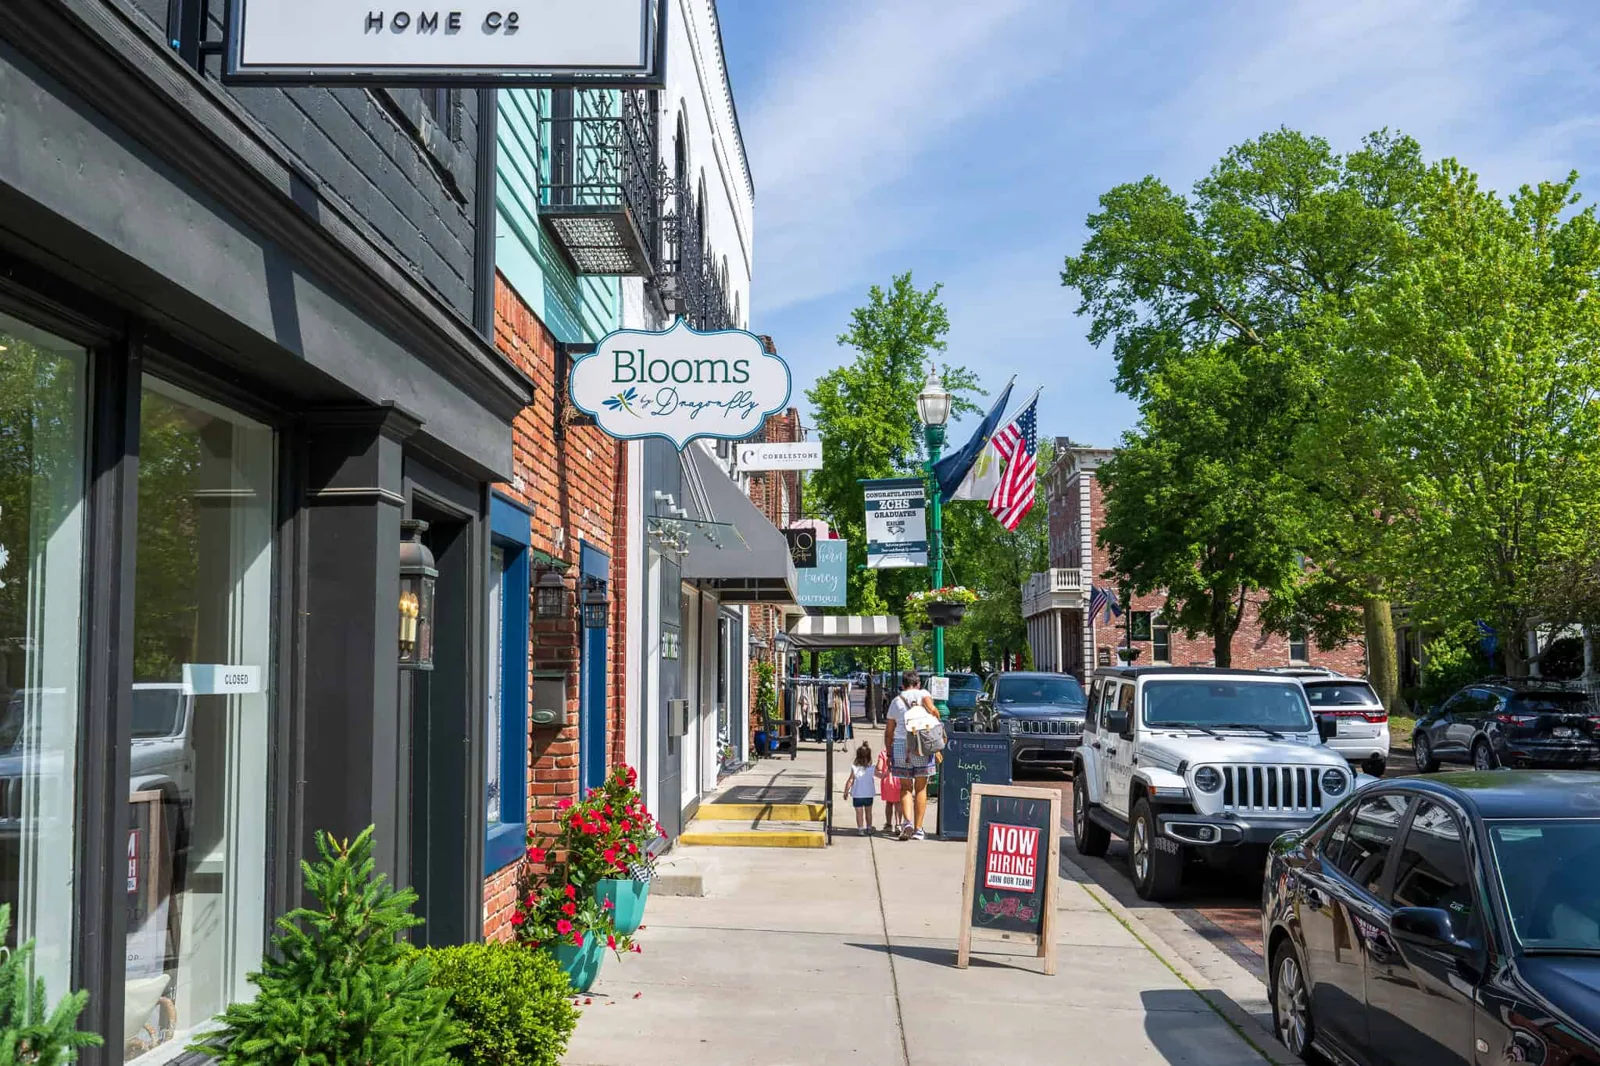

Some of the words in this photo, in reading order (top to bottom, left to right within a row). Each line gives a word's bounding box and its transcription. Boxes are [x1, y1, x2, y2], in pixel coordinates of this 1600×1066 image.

[367, 11, 462, 29] HOME
[611, 349, 750, 384] Blooms
[639, 394, 654, 410] by
[651, 386, 760, 420] Dragonfly
[866, 490, 923, 499] CONGRATULATIONS
[879, 500, 910, 510] ZCHS
[224, 674, 249, 685] CLOSED
[958, 758, 987, 771] Lunch
[991, 826, 1036, 856] NOW
[989, 853, 1034, 876] HIRING
[988, 875, 1001, 884] JOIN
[1003, 876, 1014, 885] OUR
[1015, 877, 1032, 887] TEAM!
